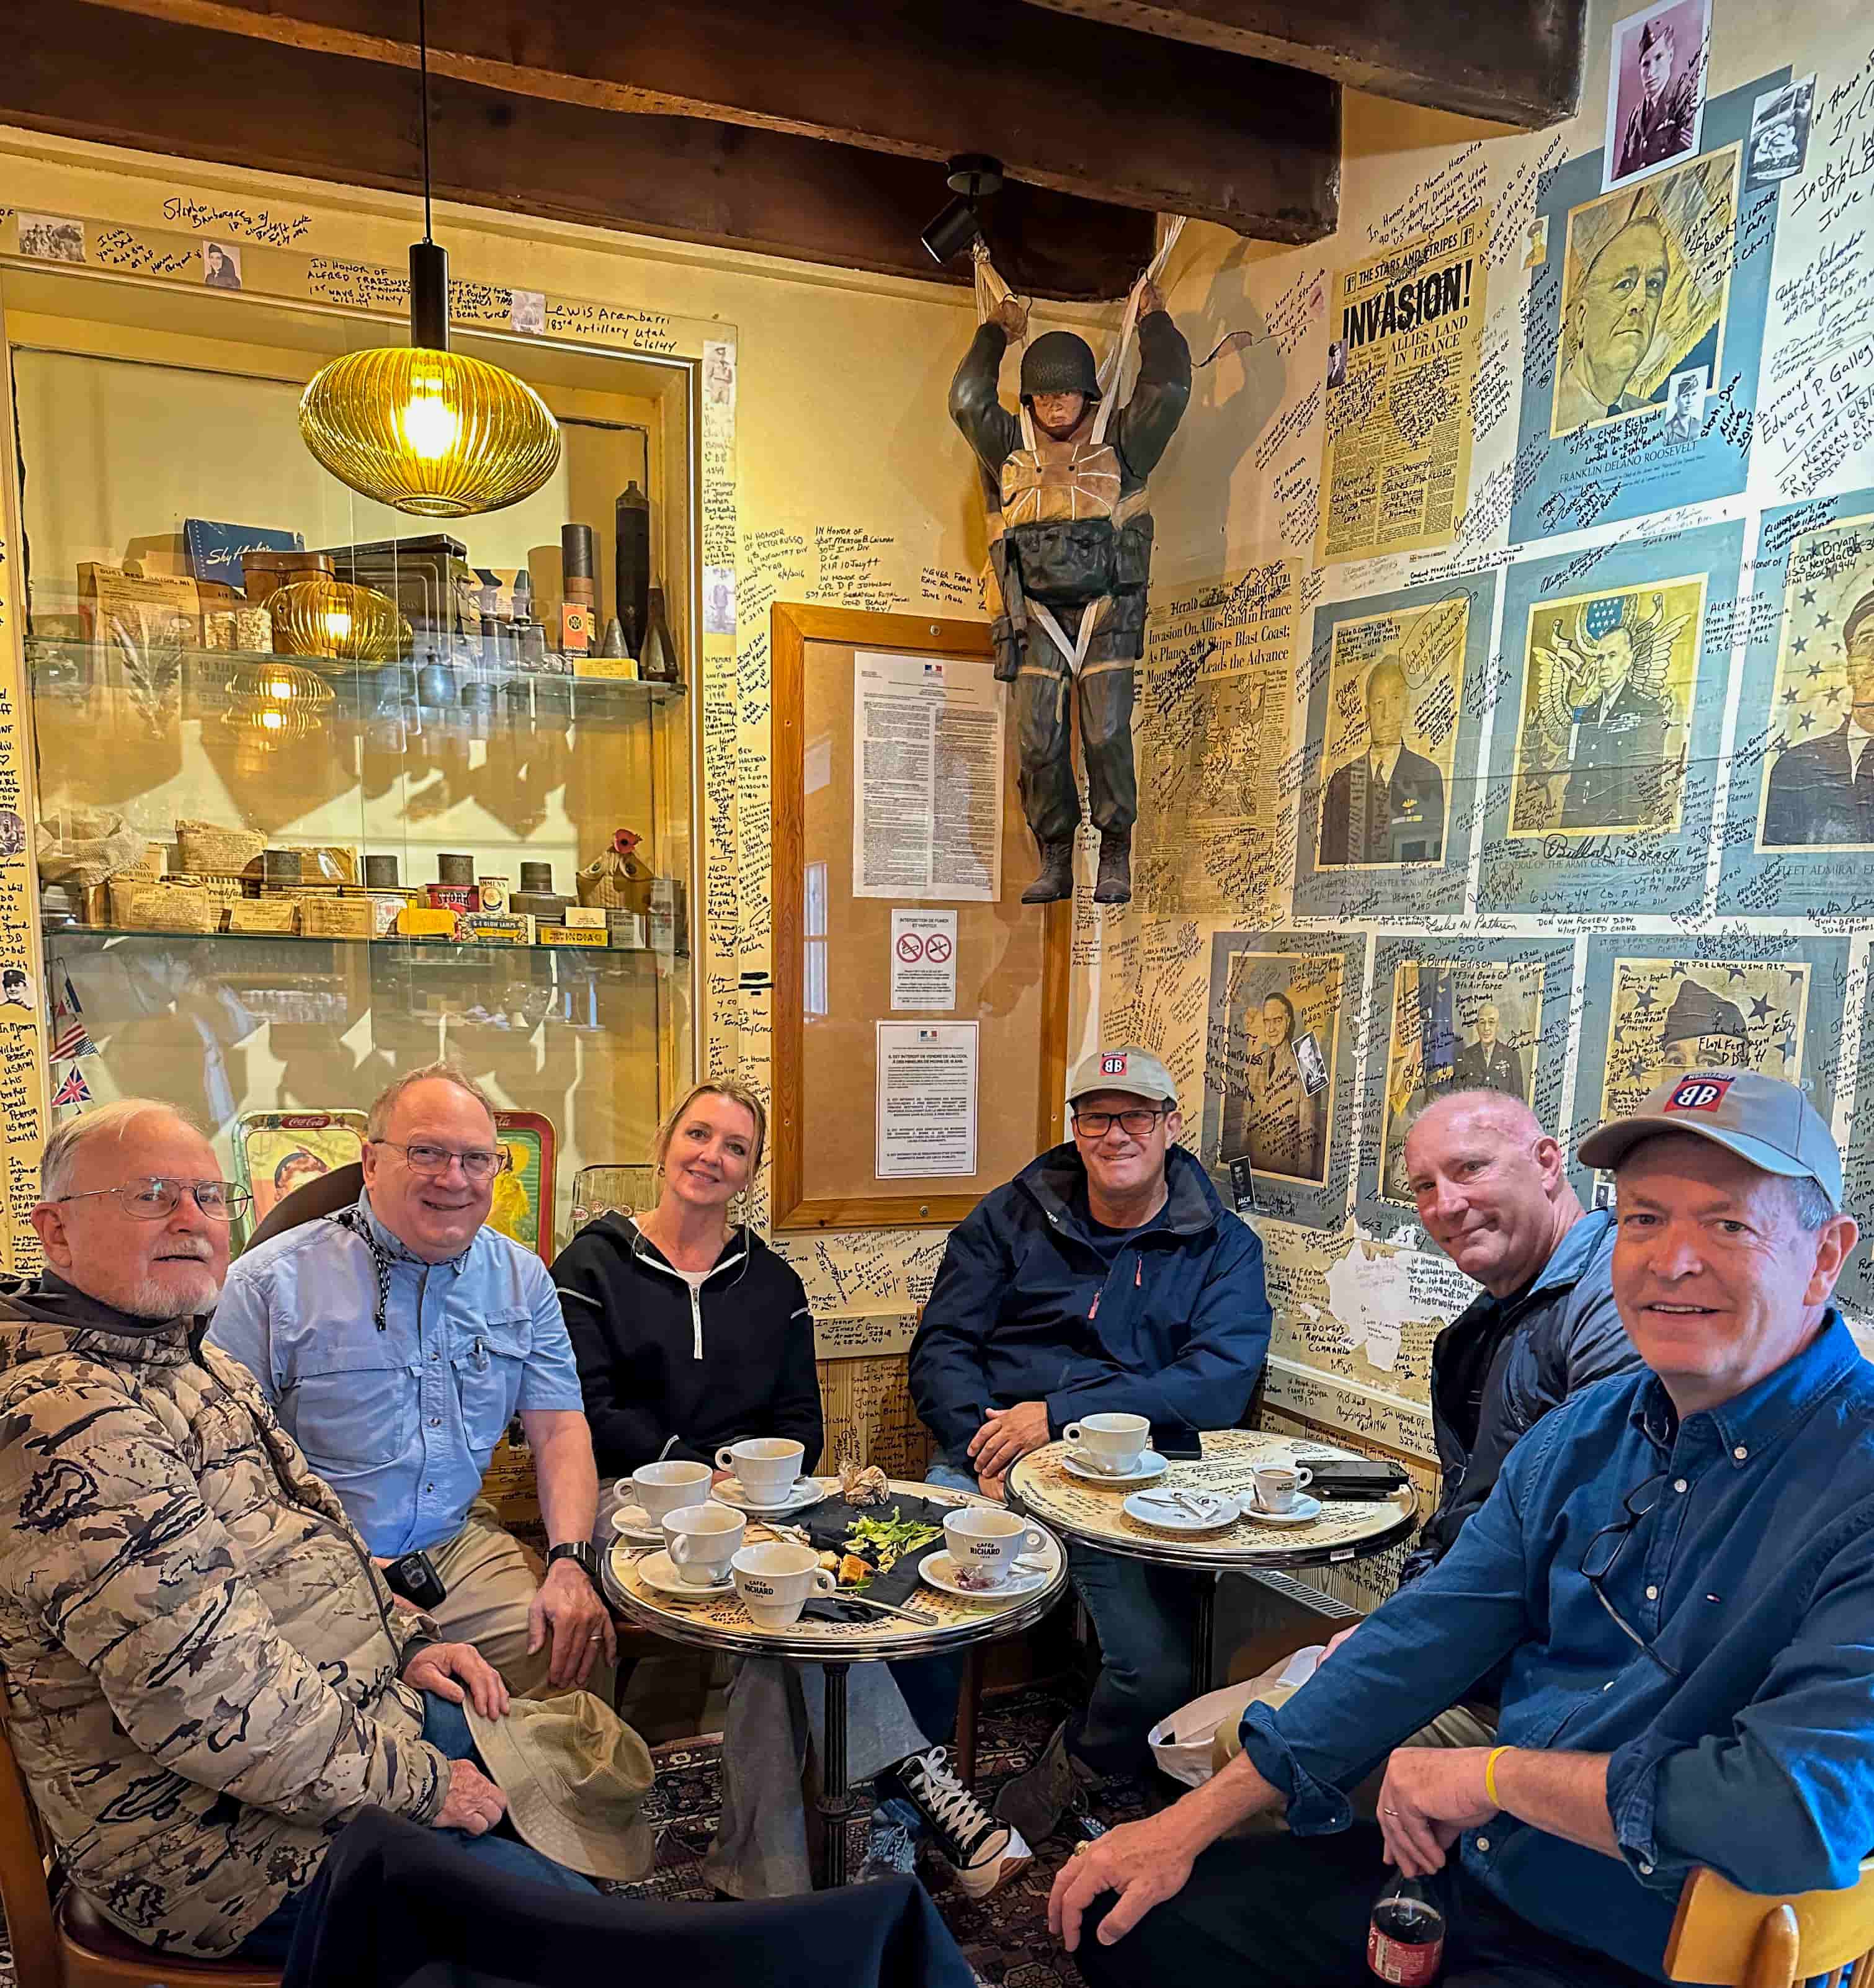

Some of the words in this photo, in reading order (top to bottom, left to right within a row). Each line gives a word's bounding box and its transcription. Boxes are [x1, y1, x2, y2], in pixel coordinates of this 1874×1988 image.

[1433, 172, 1463, 202] Division
[1394, 233, 1404, 244] US
[1409, 216, 1423, 233] Army
[1431, 189, 1454, 215] Landed
[1458, 184, 1466, 192] on
[1468, 161, 1488, 182] Utah
[1367, 224, 1378, 243] In
[1383, 205, 1404, 227] Honor
[1409, 184, 1420, 203] of
[311, 258, 327, 267] IN
[332, 262, 368, 274] HONOR
[1359, 267, 1373, 285] THE
[1375, 258, 1400, 275] STARS
[1403, 250, 1421, 268] AND
[1424, 234, 1458, 258] STRIPES
[308, 272, 349, 281] ALFRED
[377, 295, 403, 305] NAVY
[1343, 259, 1473, 349] INVASION!
[1391, 329, 1429, 354] ALLIES
[1435, 315, 1468, 338] LAND
[633, 339, 677, 352] 6/6/44
[1395, 352, 1407, 366] IN
[1414, 333, 1460, 360] FRANCE
[1470, 372, 1476, 381] IN
[1480, 350, 1499, 372] HONOR
[1501, 340, 1509, 350] OF
[1470, 371, 1489, 397] JAMES
[1481, 381, 1500, 403] ARMY
[1476, 406, 1507, 442] CHAPLAIN
[1478, 408, 1494, 427] DAY
[1559, 466, 1602, 483] FRANKLIN
[1605, 455, 1641, 471] DELANO
[1644, 440, 1697, 462] ROOSEVELT
[816, 526, 825, 535] IN
[758, 539, 779, 550] PETER
[780, 536, 803, 545] RUSSO
[1751, 558, 1772, 568] Honor
[1773, 557, 1782, 566] of
[1787, 545, 1817, 568] Frank
[1823, 530, 1860, 556] Bryant
[207, 547, 233, 566] Sky
[1785, 564, 1806, 579] USS
[848, 581, 854, 589] P
[1171, 598, 1198, 615] Herald
[1710, 601, 1731, 615] ALEX
[1149, 627, 1182, 645] Invasion
[1184, 621, 1198, 635] On,
[1200, 615, 1223, 633] Allies
[1225, 610, 1246, 628] Land
[1249, 612, 1257, 622] in
[1260, 604, 1292, 620] France
[1149, 654, 1158, 664] As
[1236, 631, 1257, 647] Blast
[1261, 625, 1290, 641] Coast;
[1202, 653, 1227, 674] Leads
[1230, 654, 1244, 669] the
[1247, 649, 1288, 666] Advance
[1499, 860, 1532, 868] GENERAL
[1535, 860, 1545, 868] OF
[1548, 860, 1563, 868] THE
[1591, 859, 1625, 868] GEORGE
[1638, 858, 1682, 867] MARSHALL
[1811, 864, 1857, 875] ADMIRAL
[438, 893, 471, 904] STORK
[1530, 892, 1538, 903] 6
[1574, 890, 1588, 899] 44
[1537, 918, 1553, 926] DON
[1427, 955, 1449, 968] Burt
[1452, 955, 1493, 969] Madison
[288, 1117, 324, 1126] Coca-Cola
[1363, 1123, 1379, 1136] 1944
[855, 1399, 878, 1409] June
[859, 1411, 879, 1419] Utah
[970, 1547, 1000, 1555] RICHARD
[745, 1587, 774, 1595] RICHARD
